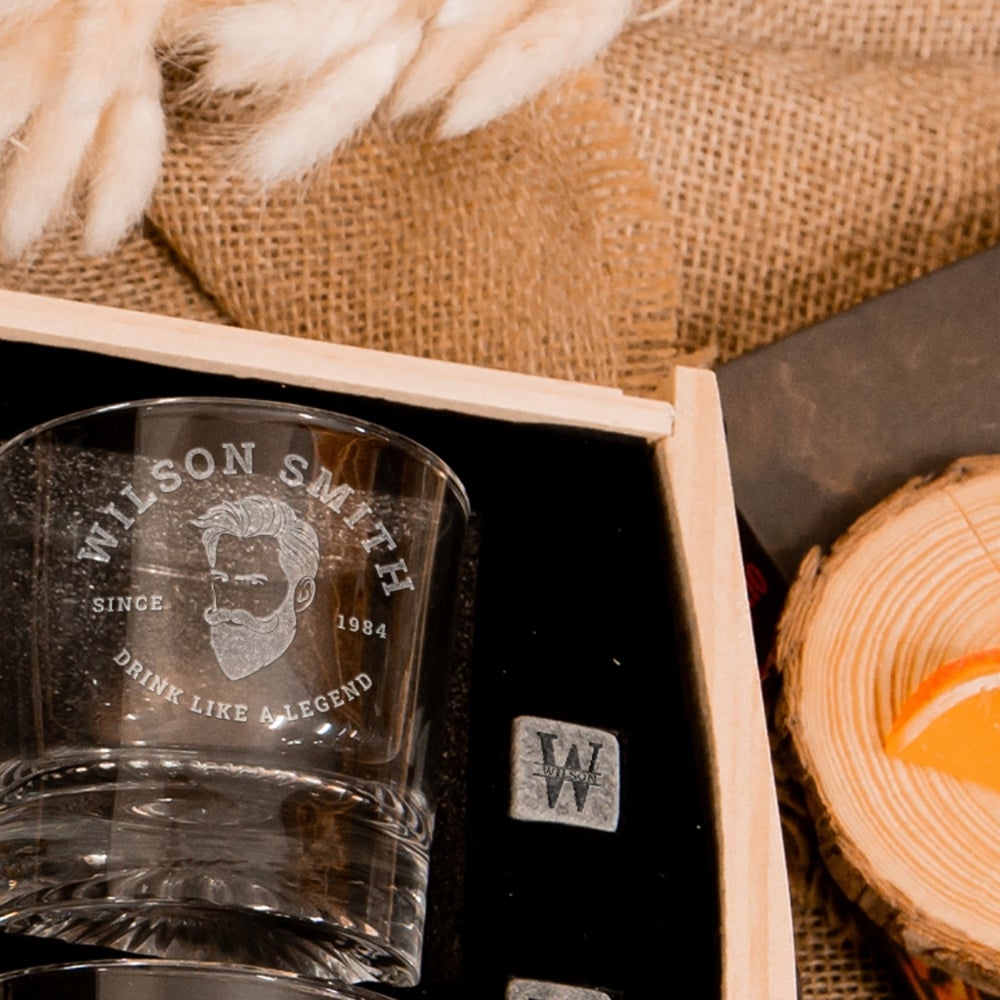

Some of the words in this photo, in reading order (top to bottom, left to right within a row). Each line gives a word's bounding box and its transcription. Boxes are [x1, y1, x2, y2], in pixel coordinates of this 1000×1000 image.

[77, 442, 256, 564] WILSON
[278, 454, 415, 597] SMITH
[92, 595, 164, 613] SINCE
[336, 614, 388, 639] 1984
[112, 648, 183, 706] DRINK
[190, 695, 249, 723] LIKE
[259, 705, 277, 724] A
[285, 672, 374, 722] LEGEND
[536, 731, 604, 813] W
